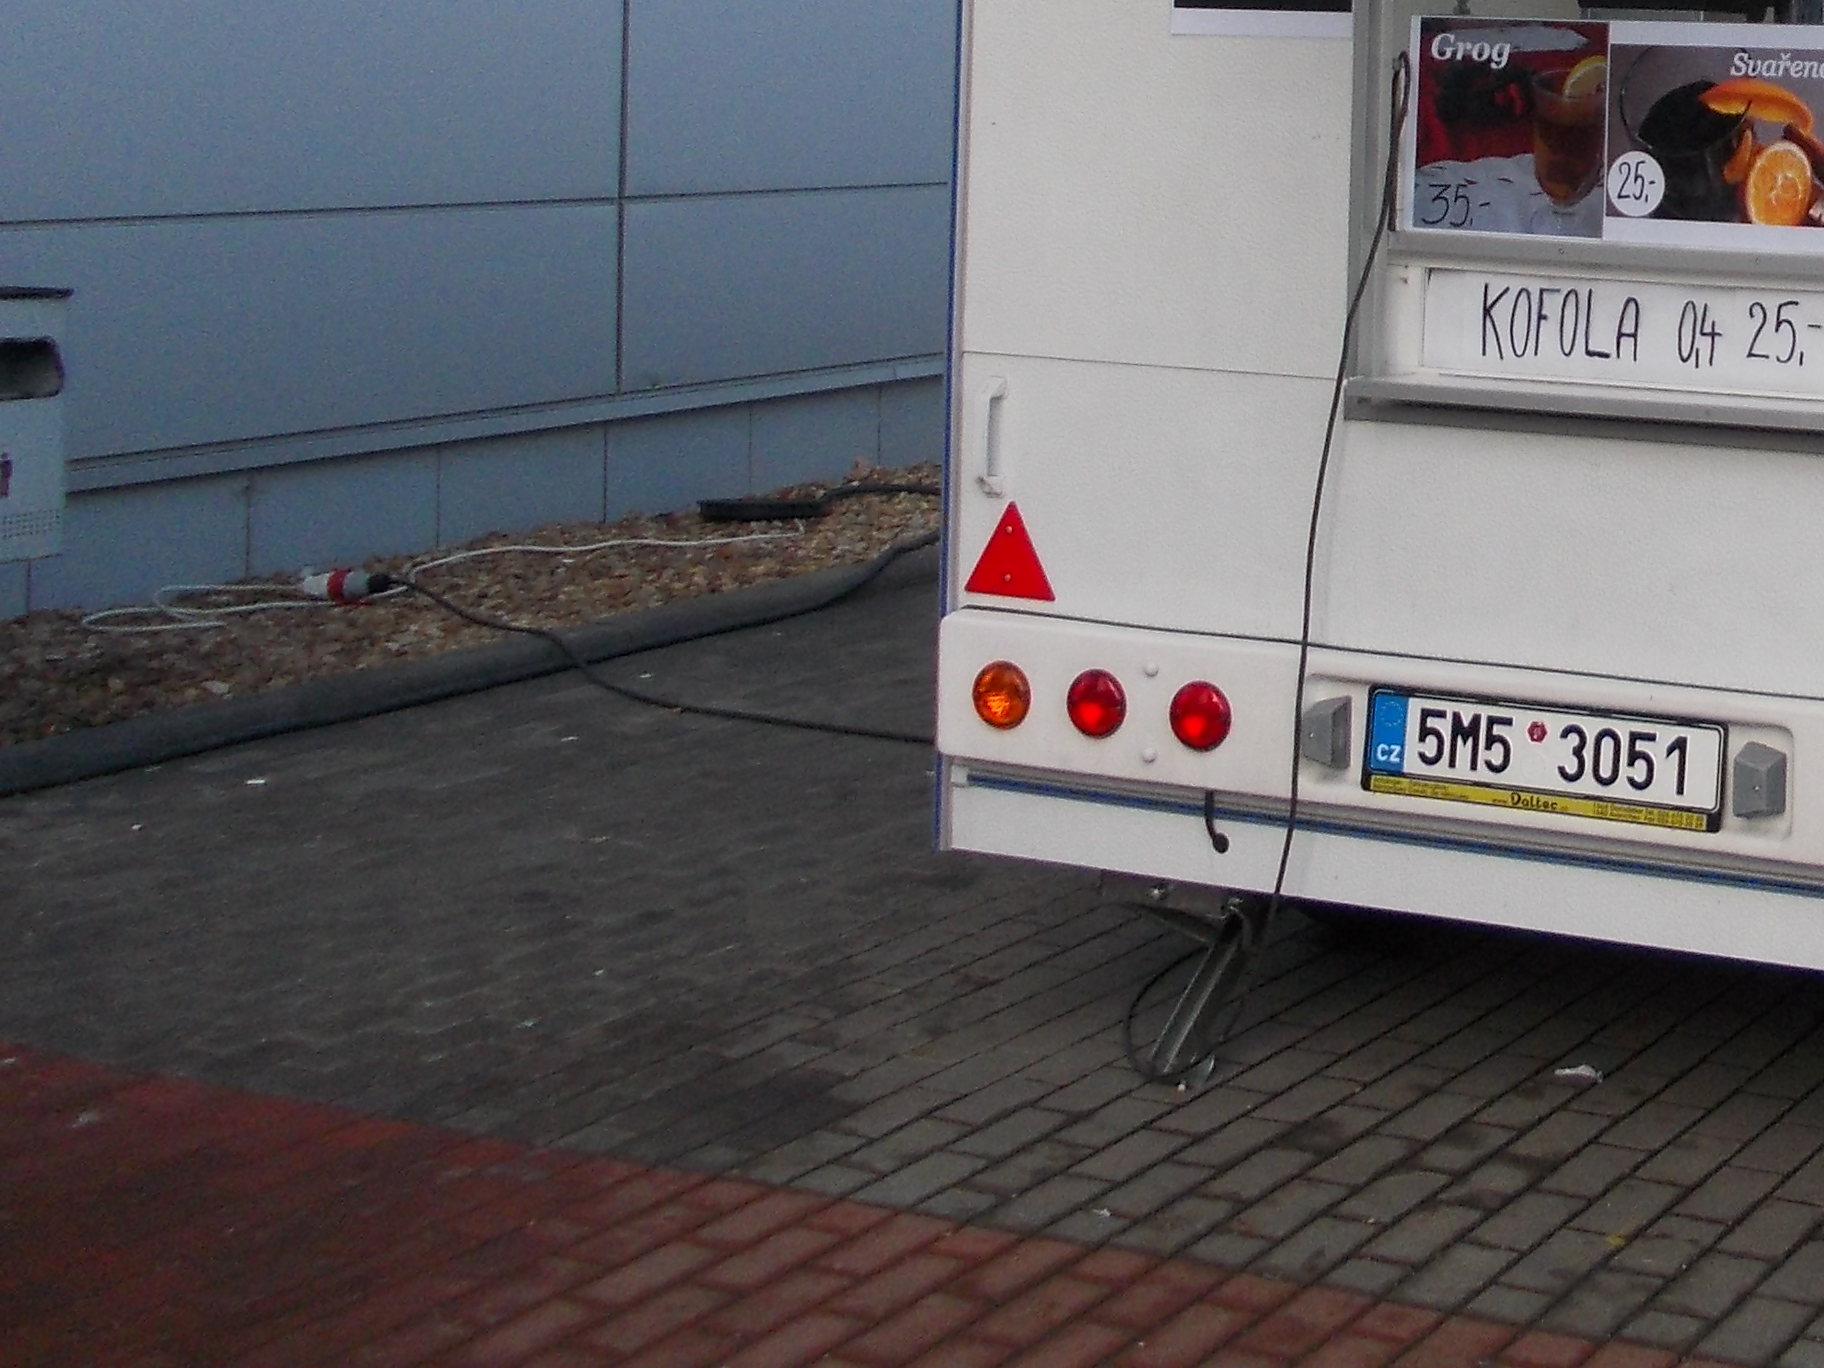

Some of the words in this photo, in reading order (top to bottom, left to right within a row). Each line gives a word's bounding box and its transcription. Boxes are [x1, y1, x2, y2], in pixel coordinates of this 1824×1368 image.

[1431, 33, 1511, 69] Grog
[1480, 282, 1640, 364] KOFOLA
[1746, 300, 1824, 368] 25,-
[1377, 743, 1402, 763] CZ
[1417, 706, 1514, 774] 5M5
[1557, 723, 1690, 796] 3051
